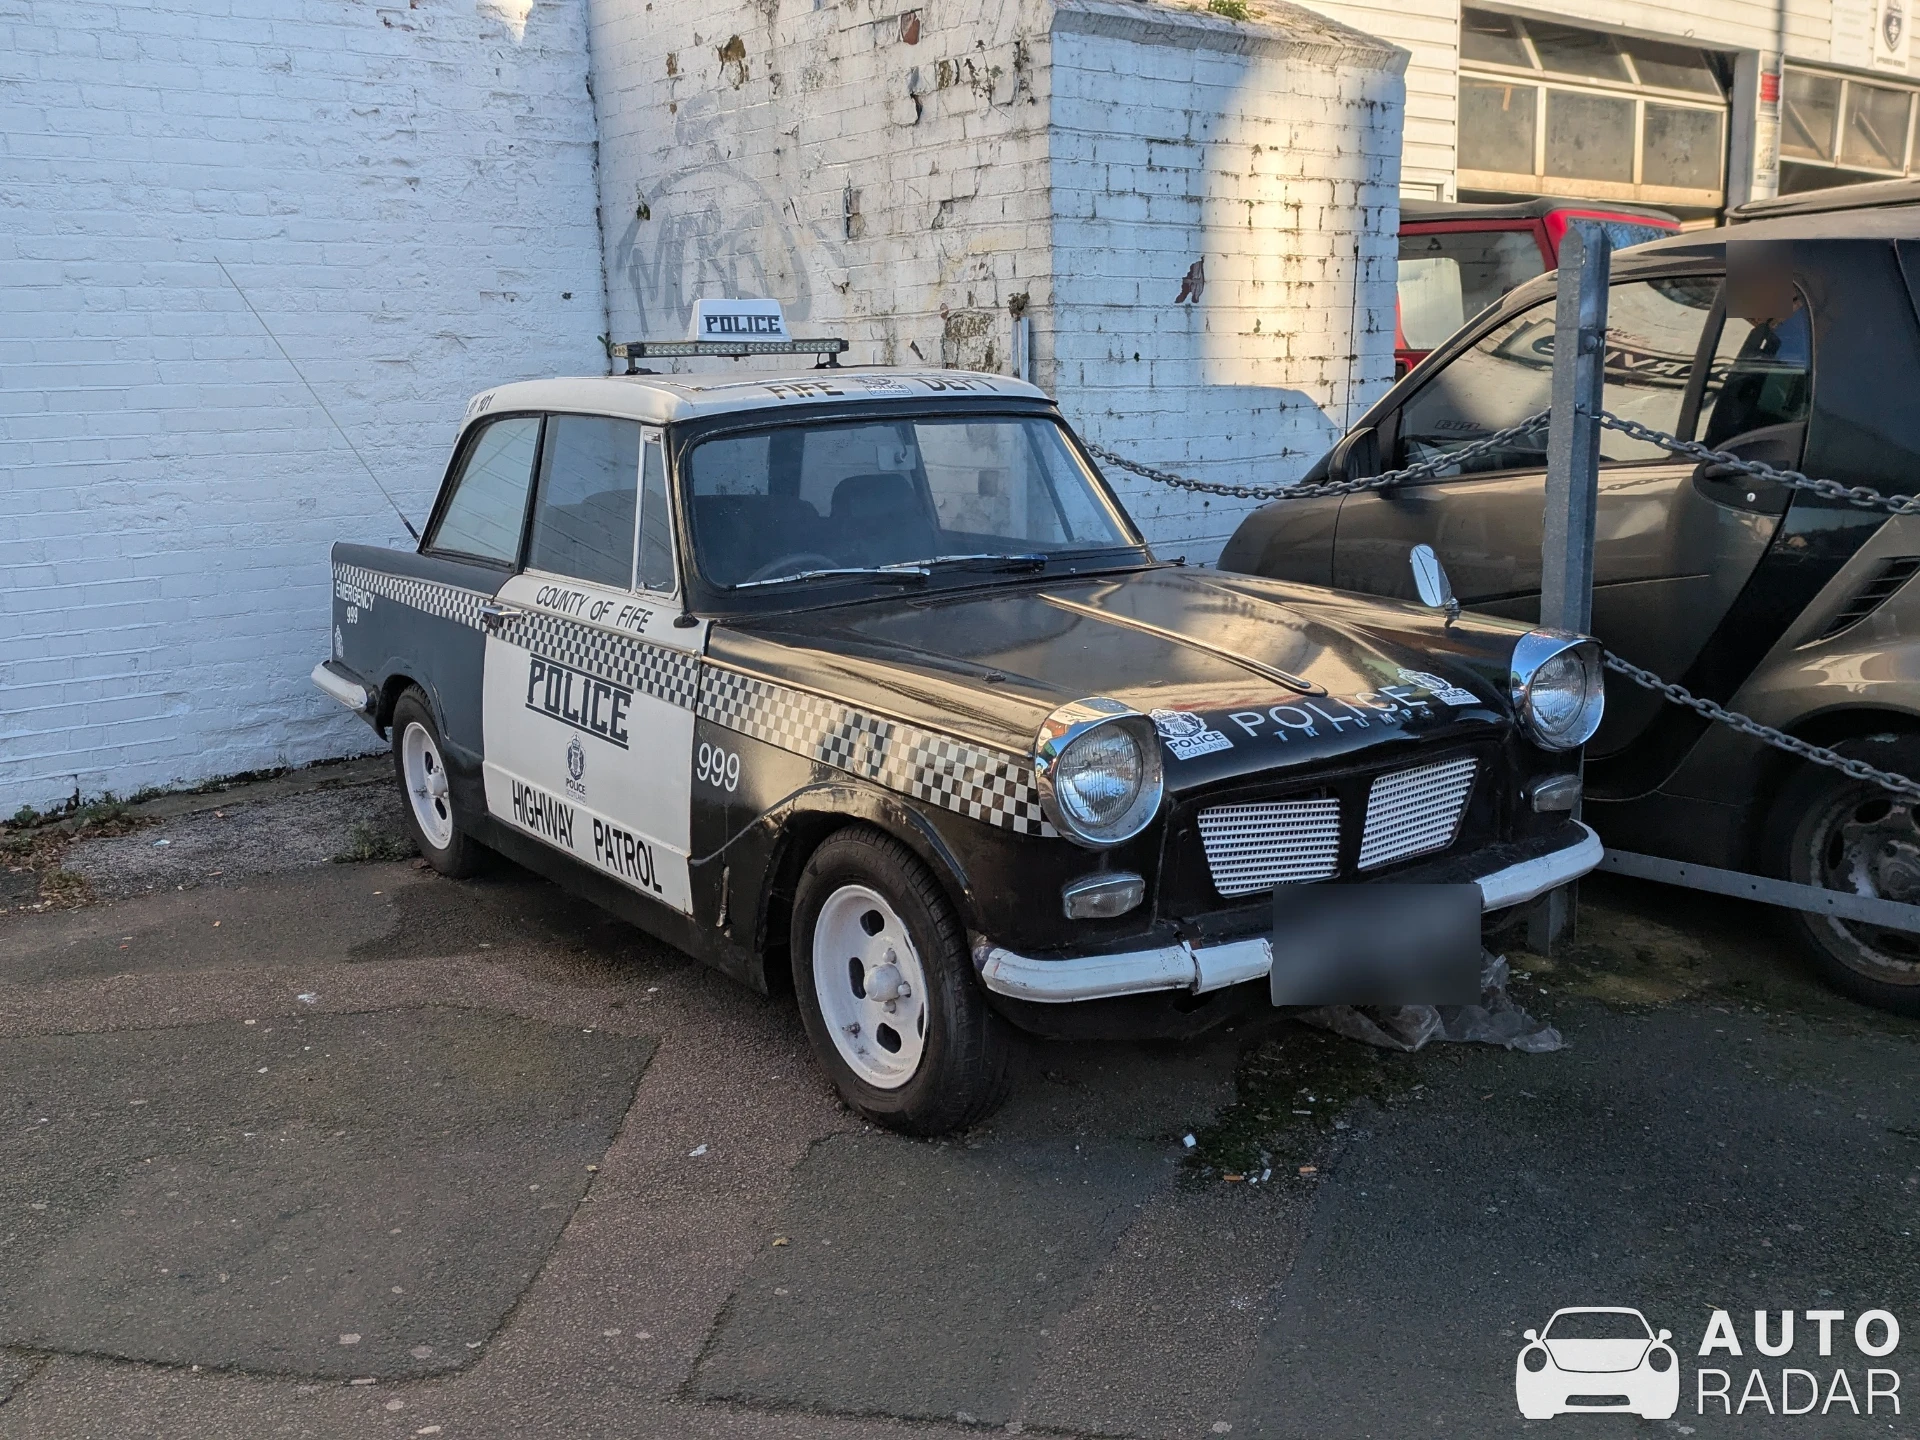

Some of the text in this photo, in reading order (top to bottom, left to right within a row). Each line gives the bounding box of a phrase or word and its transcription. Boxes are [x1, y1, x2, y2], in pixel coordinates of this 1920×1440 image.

[704, 315, 782, 334] POLICE
[763, 381, 844, 400] FIFE
[336, 580, 375, 611] EMERGENCY
[347, 606, 358, 624] 999
[536, 586, 653, 633] COUNTY OF FIFE
[526, 654, 633, 748] POLICE
[1434, 689, 1470, 698] POLICE
[1228, 686, 1428, 737] POLICE
[1169, 732, 1225, 751] POLICE
[1176, 740, 1229, 759] SCOTLAND
[697, 743, 740, 792] 999
[566, 778, 586, 795] POLICE
[512, 780, 663, 894] HIGHWAY PATROL
